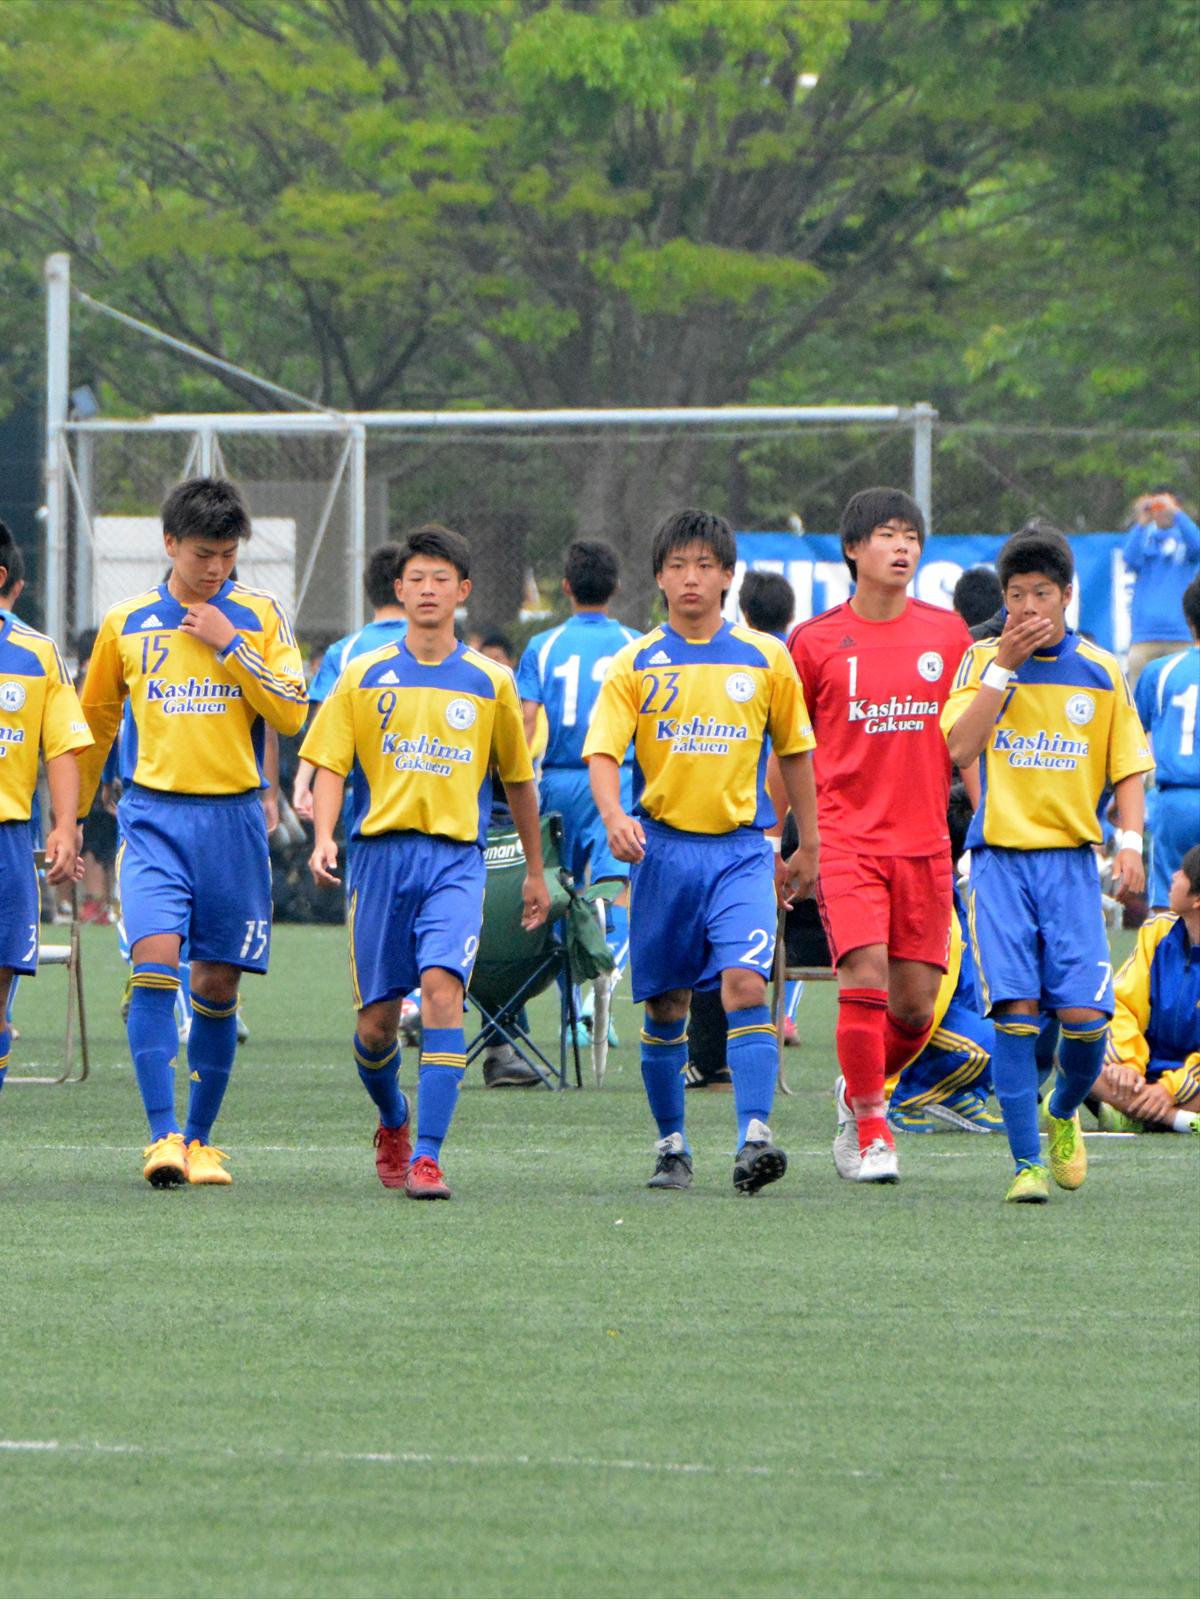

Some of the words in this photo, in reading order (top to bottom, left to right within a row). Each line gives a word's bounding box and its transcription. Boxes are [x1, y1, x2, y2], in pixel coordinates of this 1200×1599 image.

[141, 634, 171, 675] 15
[146, 677, 243, 700] Kashima
[847, 656, 858, 697] 1
[162, 699, 228, 716] Gakuen
[639, 672, 680, 715] 23
[848, 695, 939, 722] Kashima
[996, 686, 1017, 725] 7
[377, 691, 397, 730] 9
[865, 718, 925, 734] Gakuen
[381, 732, 473, 764] Kashima
[671, 737, 729, 755] akuen
[1008, 751, 1077, 770] Gakuen
[394, 754, 452, 777] Gakuen
[483, 844, 516, 860] man
[22, 925, 37, 961] 3
[240, 920, 267, 960] 15
[461, 935, 478, 967] 9
[1093, 961, 1112, 1001] 7
